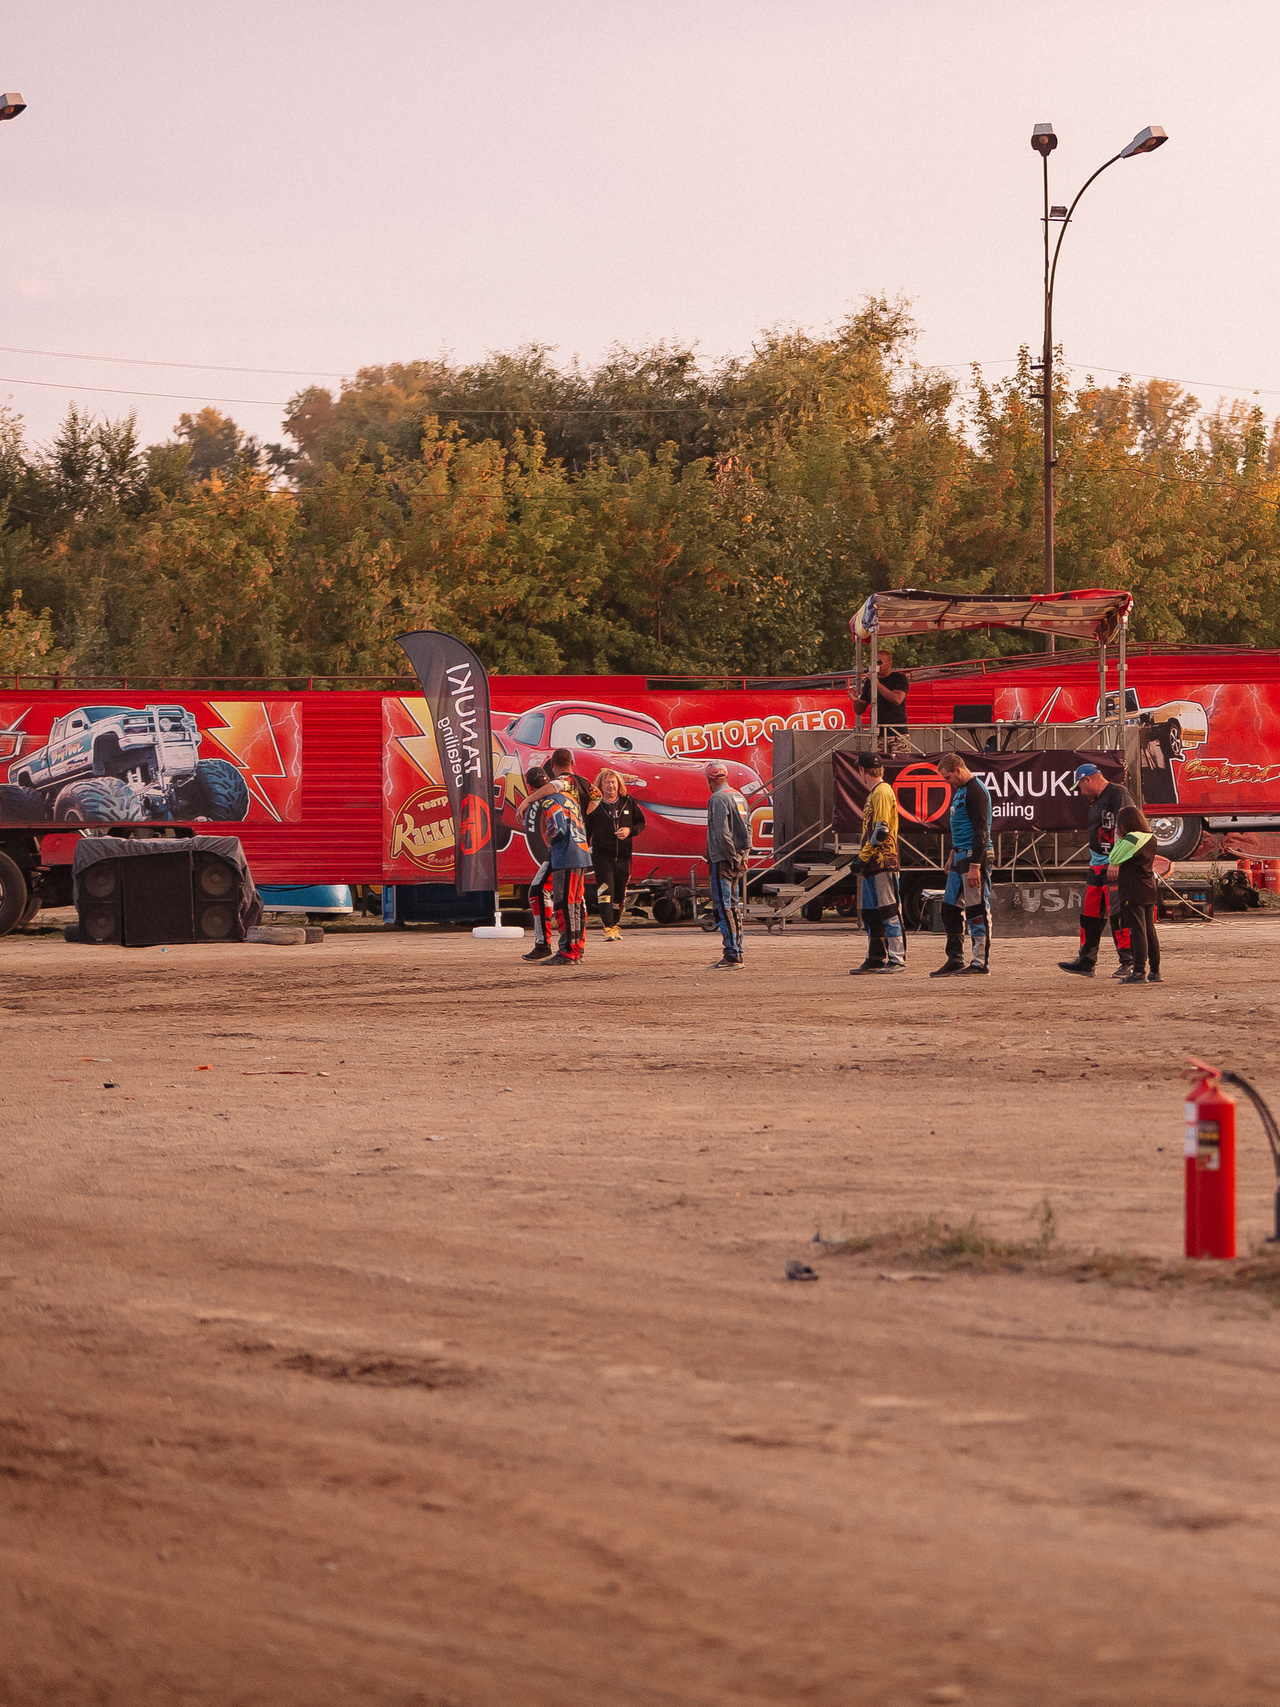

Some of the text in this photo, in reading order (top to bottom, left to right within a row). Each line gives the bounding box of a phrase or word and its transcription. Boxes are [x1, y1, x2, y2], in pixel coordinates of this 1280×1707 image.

[992, 802, 1034, 820] ailing
[393, 813, 455, 856] Каска
[1021, 888, 1082, 913] USA
